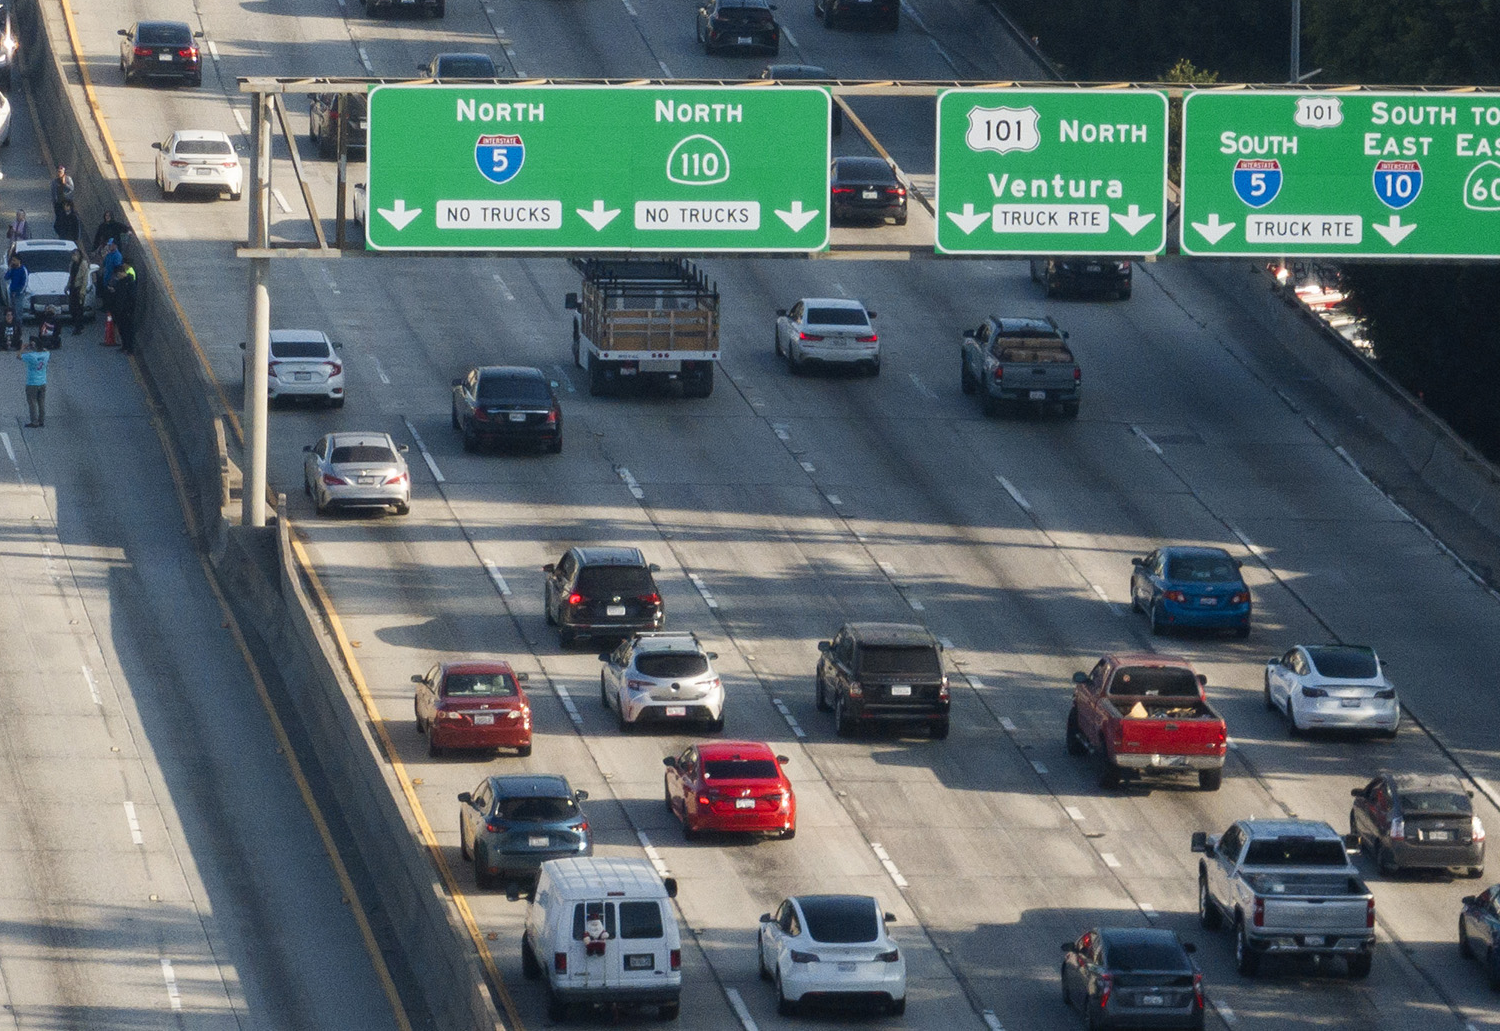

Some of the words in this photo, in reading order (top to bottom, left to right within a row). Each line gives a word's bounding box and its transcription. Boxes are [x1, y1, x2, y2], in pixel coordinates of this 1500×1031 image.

[457, 99, 545, 122] NORTH
[655, 99, 743, 123] NORTH
[1305, 105, 1332, 120] 101
[1371, 101, 1457, 126] SOUTH
[1471, 106, 1500, 126] TO
[482, 136, 518, 145] INTERSTATE
[986, 119, 1022, 142] 101
[1059, 119, 1148, 143] NORTH
[1219, 131, 1298, 155] SOUTH
[1364, 132, 1433, 156] EAST
[492, 148, 509, 172] 5
[681, 153, 719, 176] 110
[1240, 161, 1276, 170] INTERSTATE
[1381, 162, 1416, 171] INTERSTATE
[987, 173, 1123, 199] Ventura
[1250, 173, 1267, 197] 5
[1385, 174, 1412, 198] 10
[447, 207, 471, 222] NO
[481, 207, 551, 222] TRUCKS
[645, 208, 669, 223] NO
[679, 208, 749, 223] TRUCKS
[1002, 211, 1059, 226] TRUCK
[1068, 211, 1101, 227] RTE
[1255, 221, 1312, 237] TRUCK
[1321, 222, 1354, 237] RTE
